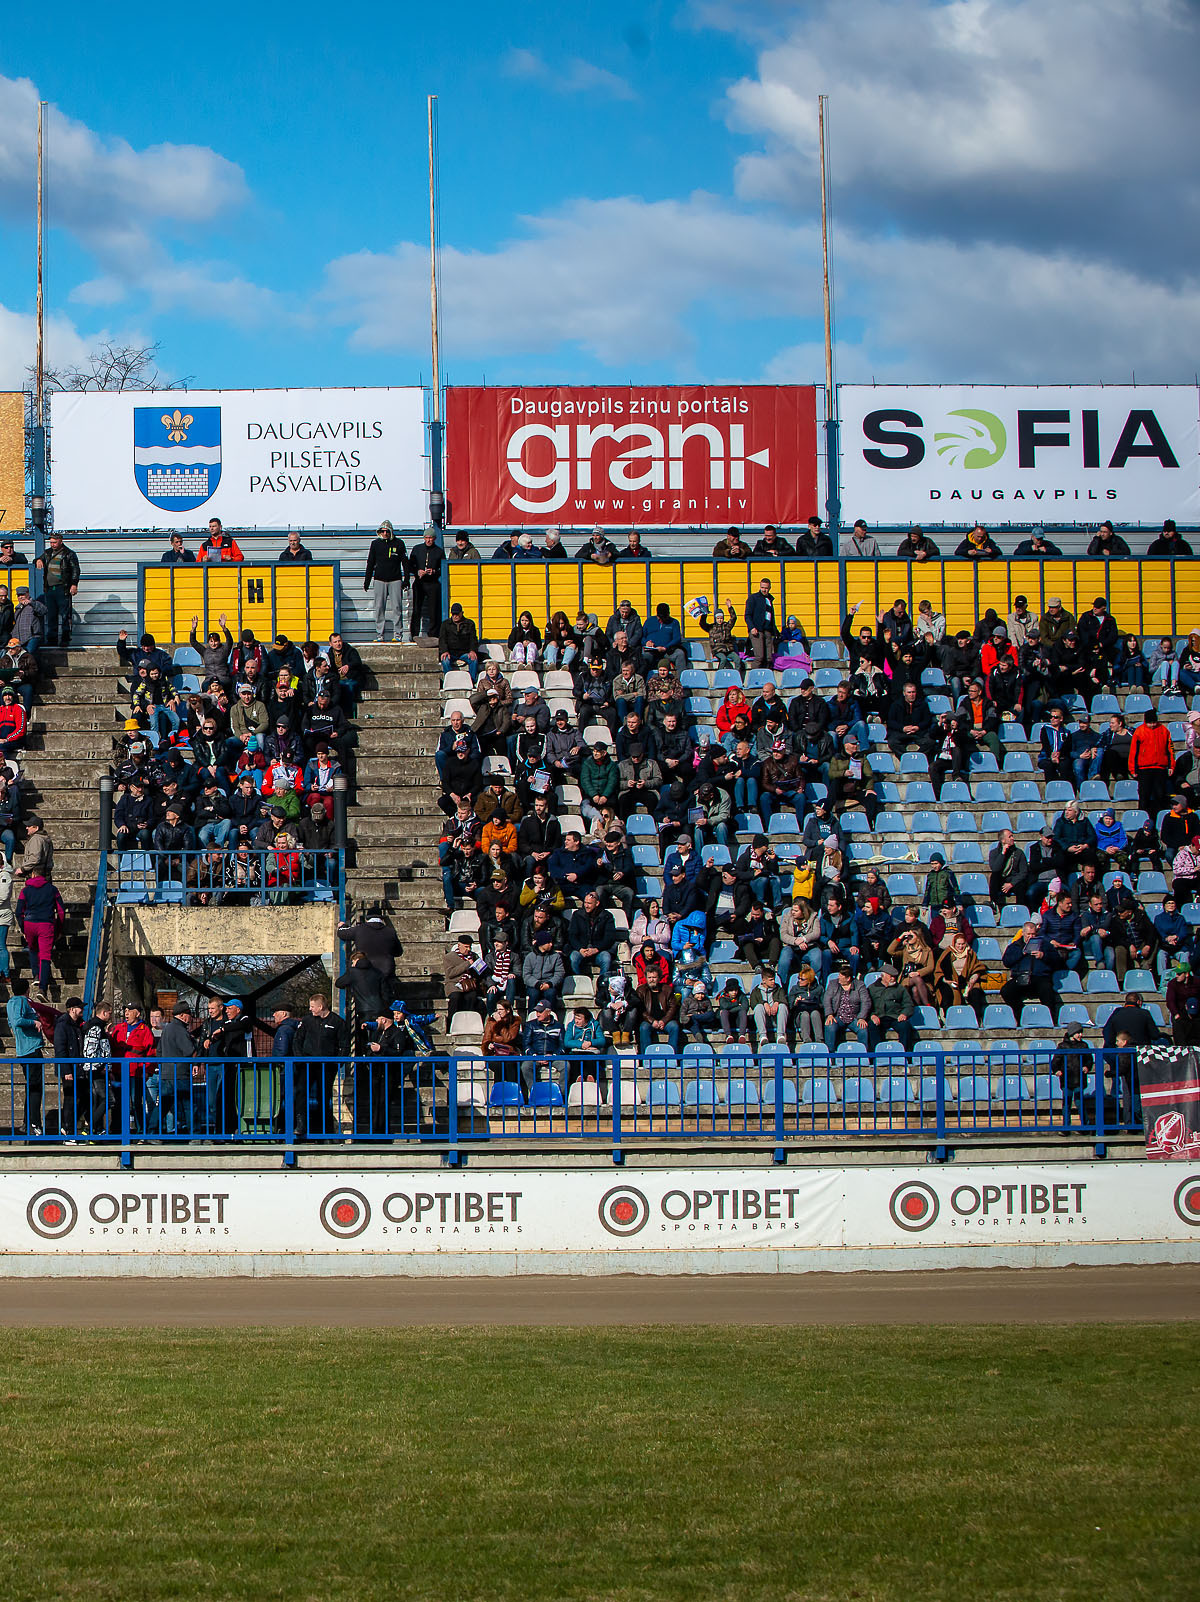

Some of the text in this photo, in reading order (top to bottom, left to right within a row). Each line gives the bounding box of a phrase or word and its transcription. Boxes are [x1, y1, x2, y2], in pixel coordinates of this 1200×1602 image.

[511, 396, 749, 418] Daugavpils ziņu portāls
[247, 421, 383, 440] DAUGAVPILS
[271, 446, 361, 469] PILSĒTAS
[250, 471, 383, 494] PAŠVALDĪBA
[929, 489, 1118, 500] DAUGAVPILS
[574, 496, 748, 512] www.grani.lv
[248, 578, 264, 603] H
[95, 667, 104, 675] 15
[413, 663, 422, 671] 15
[408, 691, 416, 699] 14
[415, 719, 424, 727] 13
[87, 751, 96, 759] 12
[417, 748, 425, 756] 12
[419, 869, 425, 877] 8
[423, 967, 428, 975] 5
[661, 1189, 799, 1220] OPTIBET
[951, 1184, 1086, 1215] OPTIBET
[89, 1194, 229, 1223] OPTIBET
[383, 1192, 522, 1223] OPTIBET
[1041, 1214, 1086, 1224] BĀRS
[182, 1225, 229, 1234] BĀRS
[475, 1223, 522, 1232] BĀRS
[753, 1220, 799, 1229] BĀRS
